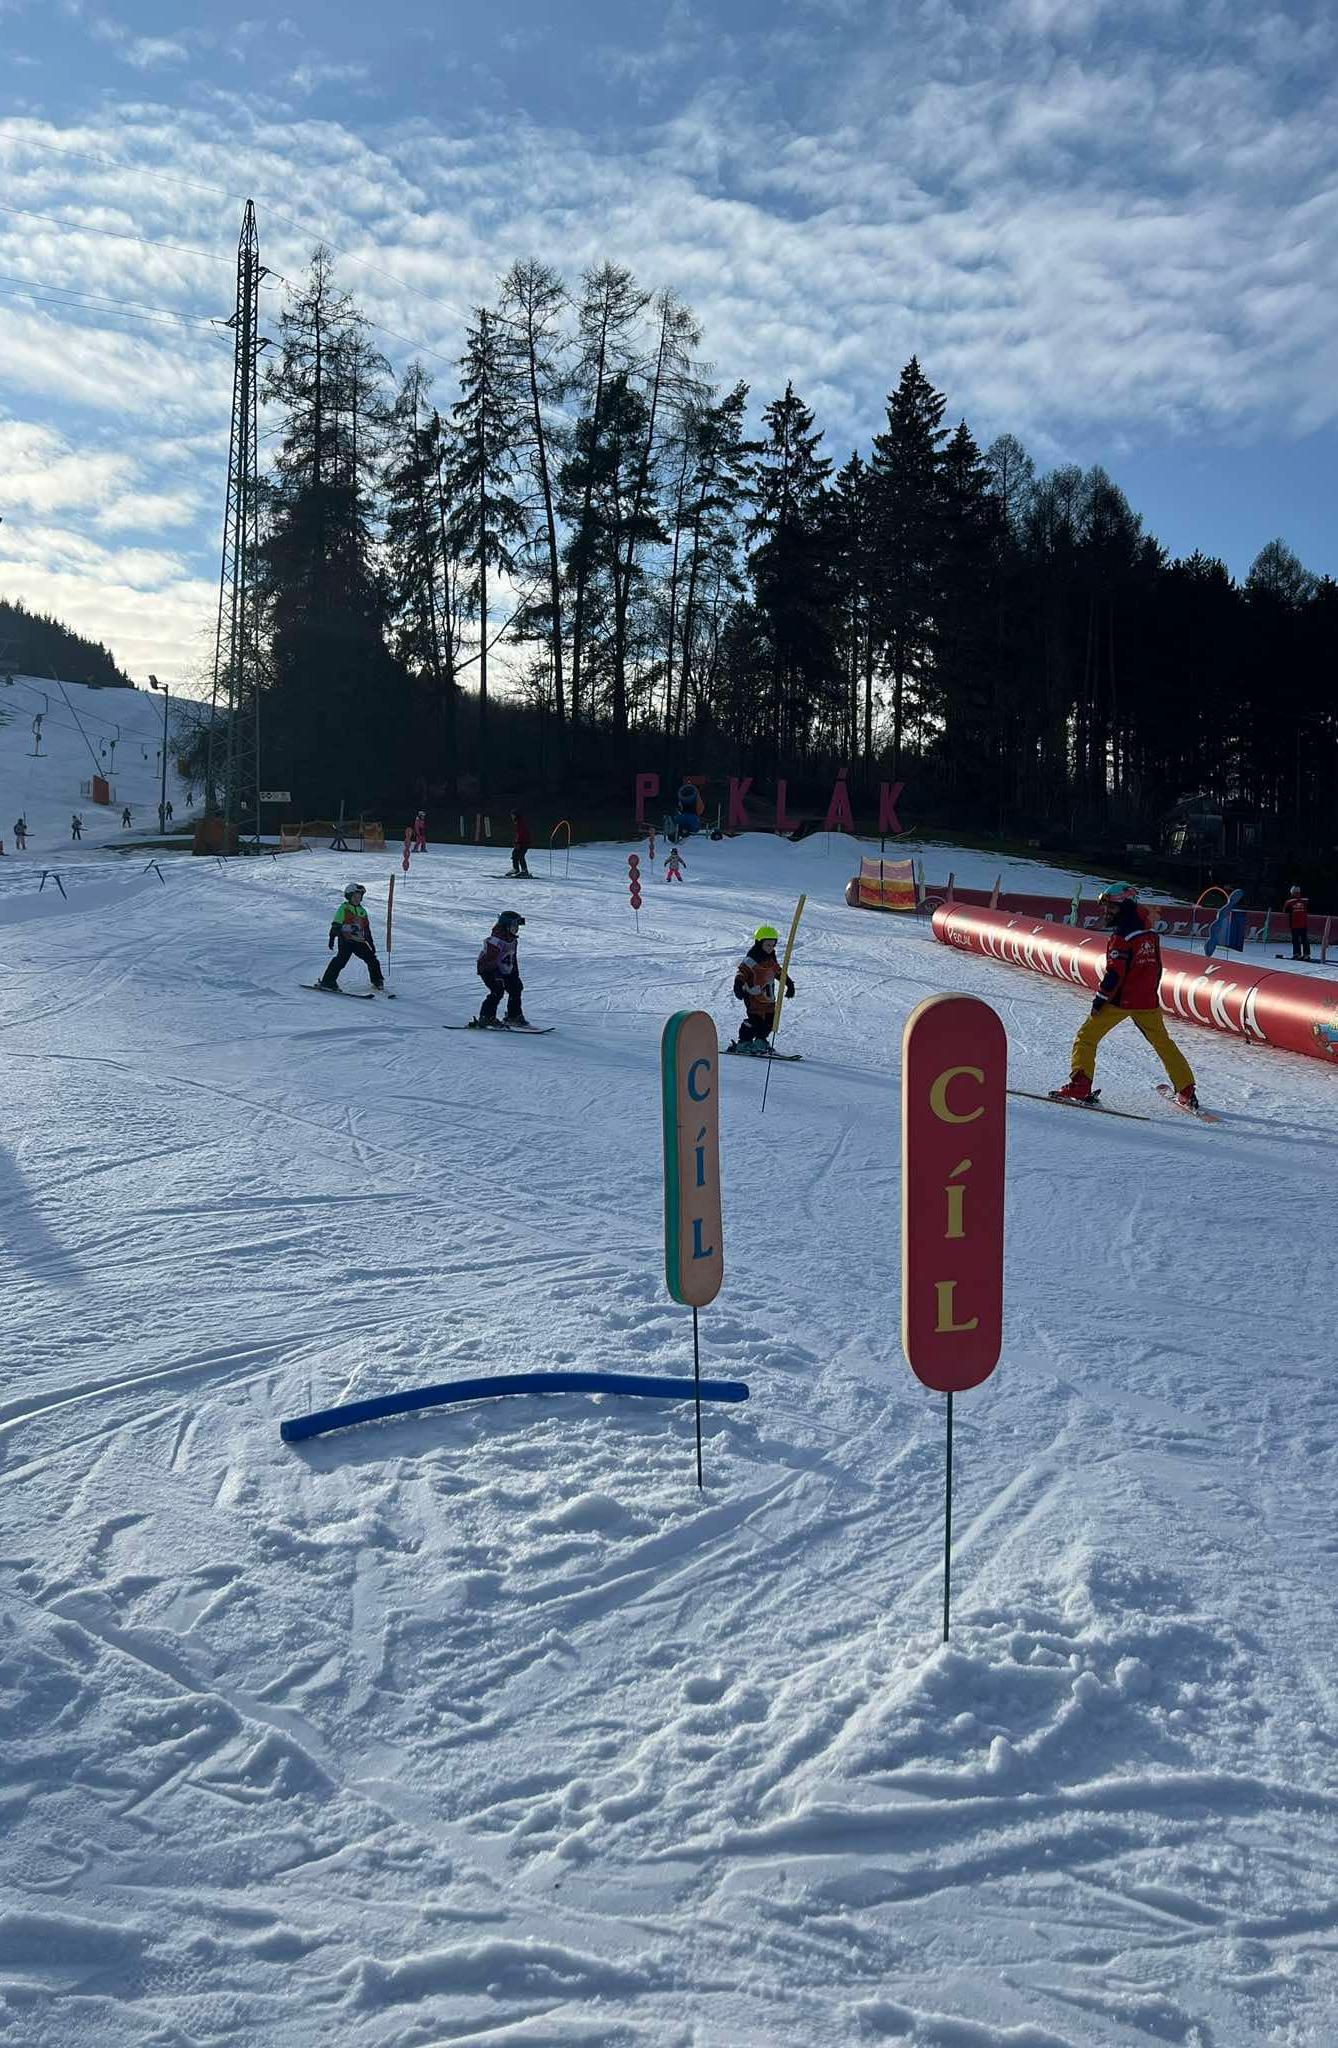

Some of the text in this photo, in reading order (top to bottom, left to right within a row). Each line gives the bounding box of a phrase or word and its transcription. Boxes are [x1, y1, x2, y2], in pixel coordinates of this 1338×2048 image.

[635, 768, 905, 833] PKLÁK
[1095, 953, 1267, 1040] LIČKA
[687, 1058, 713, 1260] CÍL
[929, 1065, 986, 1333] CÍL
